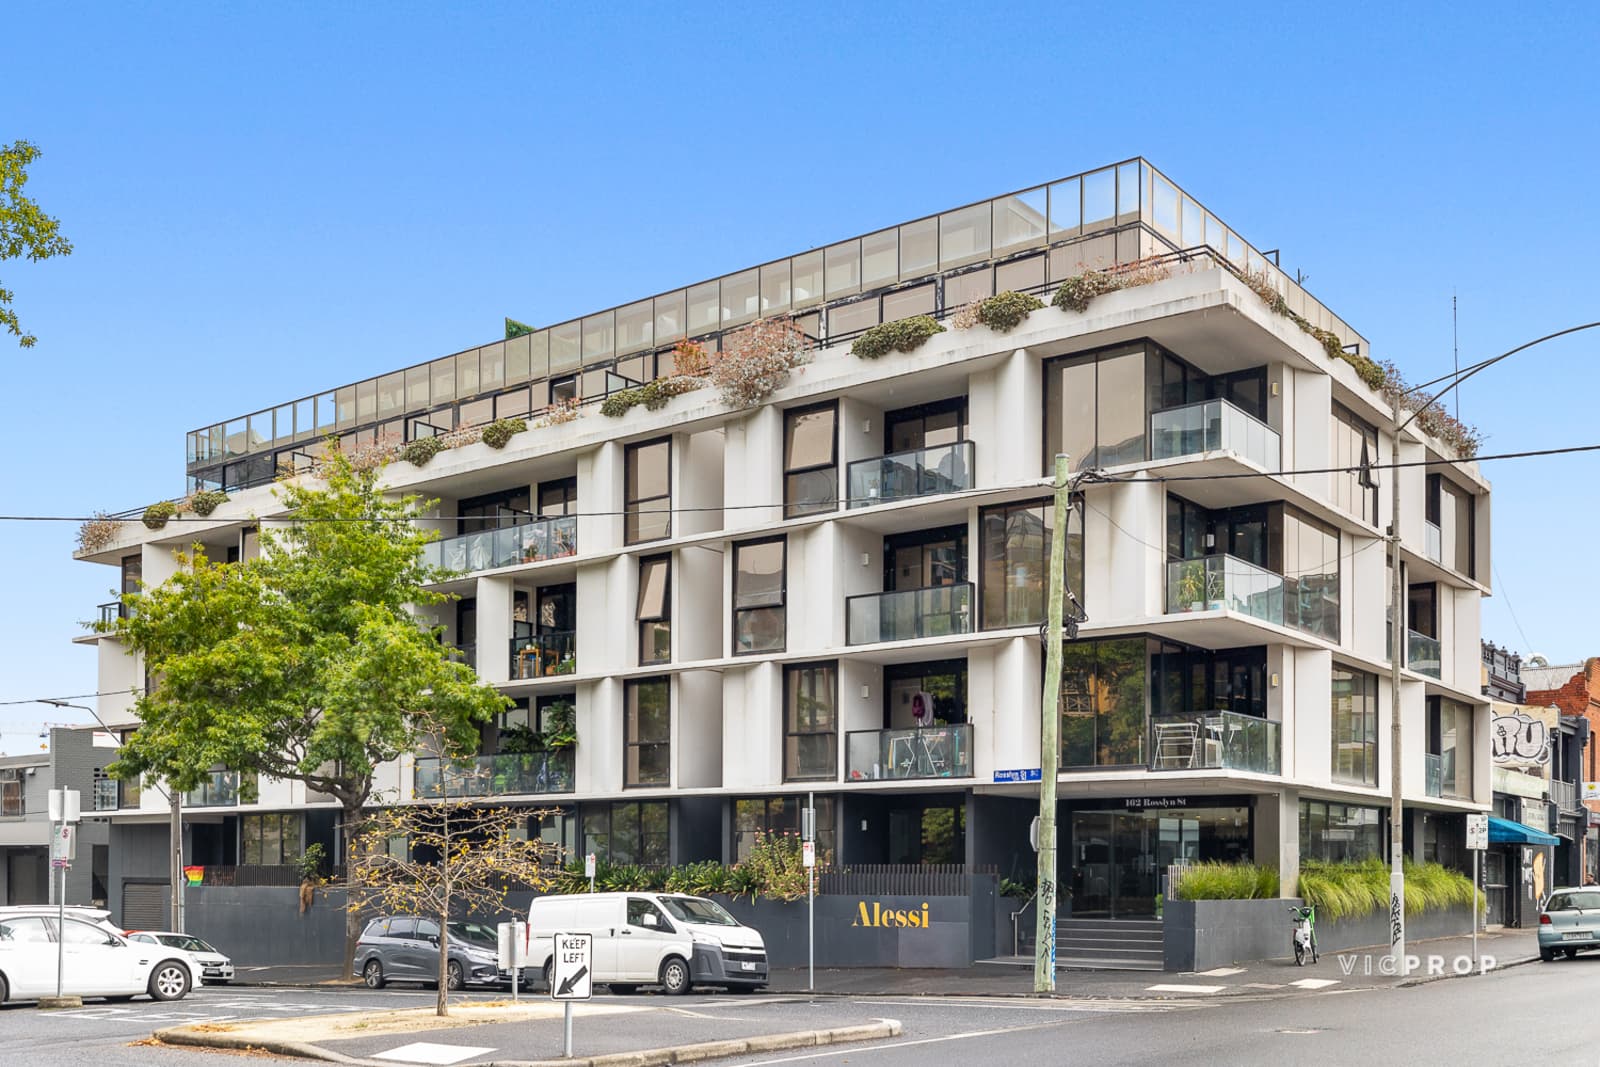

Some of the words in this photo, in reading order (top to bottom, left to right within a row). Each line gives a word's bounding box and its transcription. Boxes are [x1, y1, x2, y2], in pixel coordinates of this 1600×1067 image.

[1143, 798, 1176, 808] Rosslyn
[1177, 797, 1187, 806] St
[851, 900, 930, 929] Alessi
[562, 939, 586, 949] KEEP
[563, 953, 584, 963] LEFT
